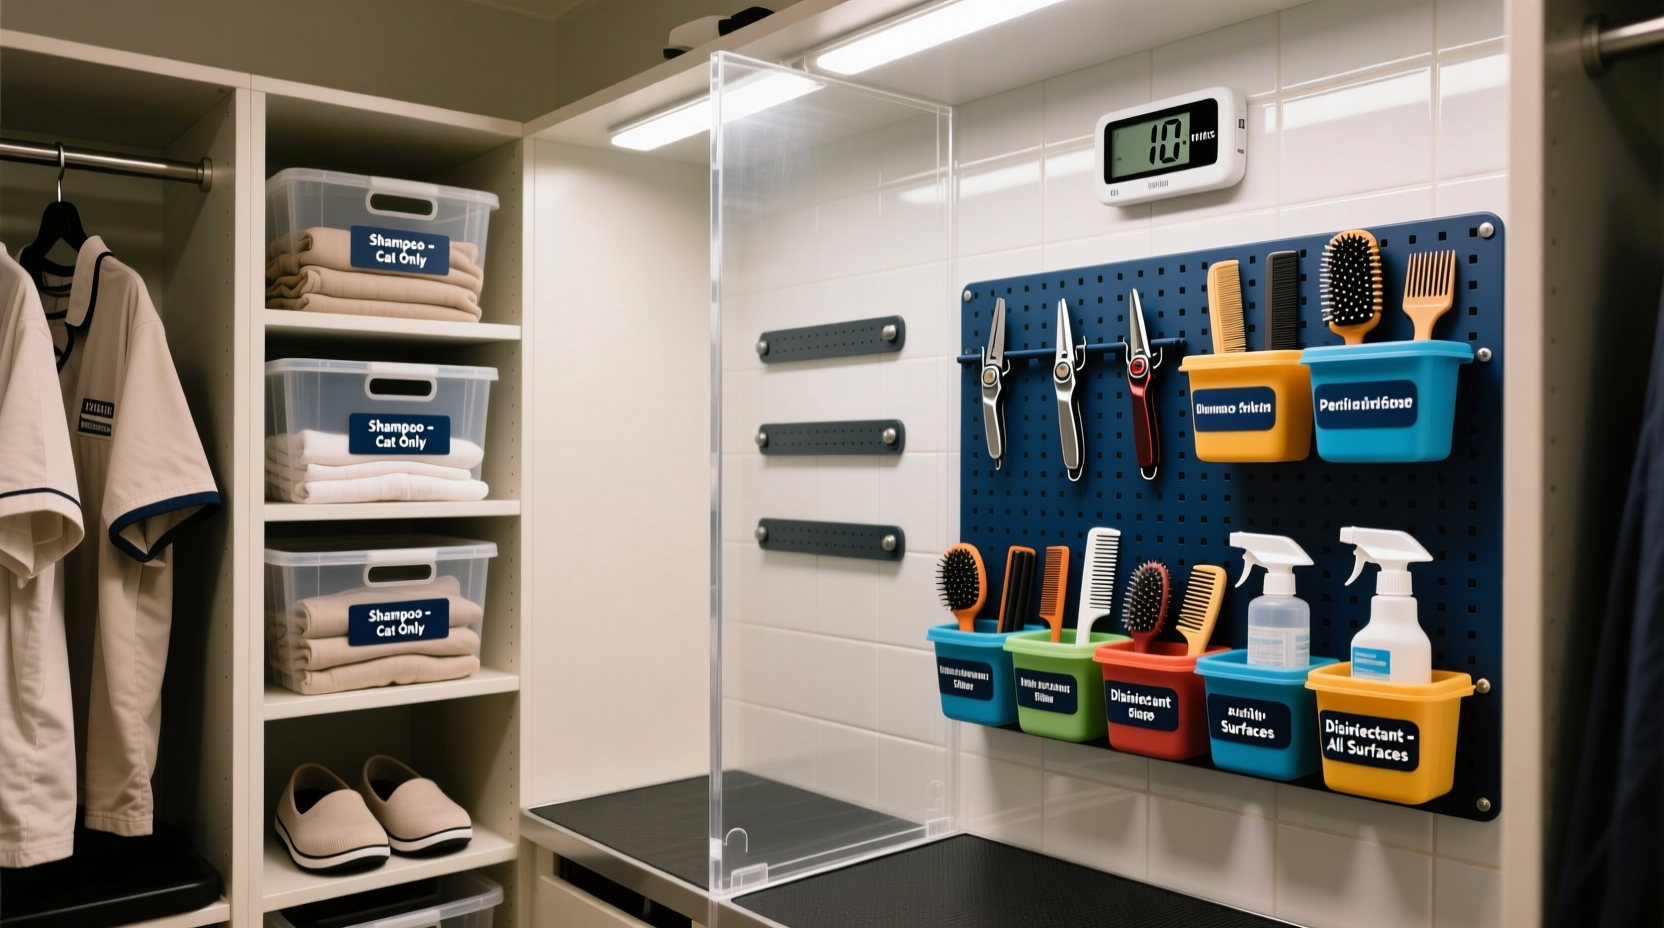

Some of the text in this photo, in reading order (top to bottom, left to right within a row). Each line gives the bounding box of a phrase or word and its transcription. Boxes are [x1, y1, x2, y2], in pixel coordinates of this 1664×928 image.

[399, 251, 427, 268] Only
[368, 419, 425, 436] Shampoo
[375, 435, 427, 451] Cat Only
[368, 609, 423, 625] Shampoo
[398, 621, 425, 636] Only
[1221, 719, 1275, 739] Surfaces
[1326, 736, 1409, 762] All Surfaces
